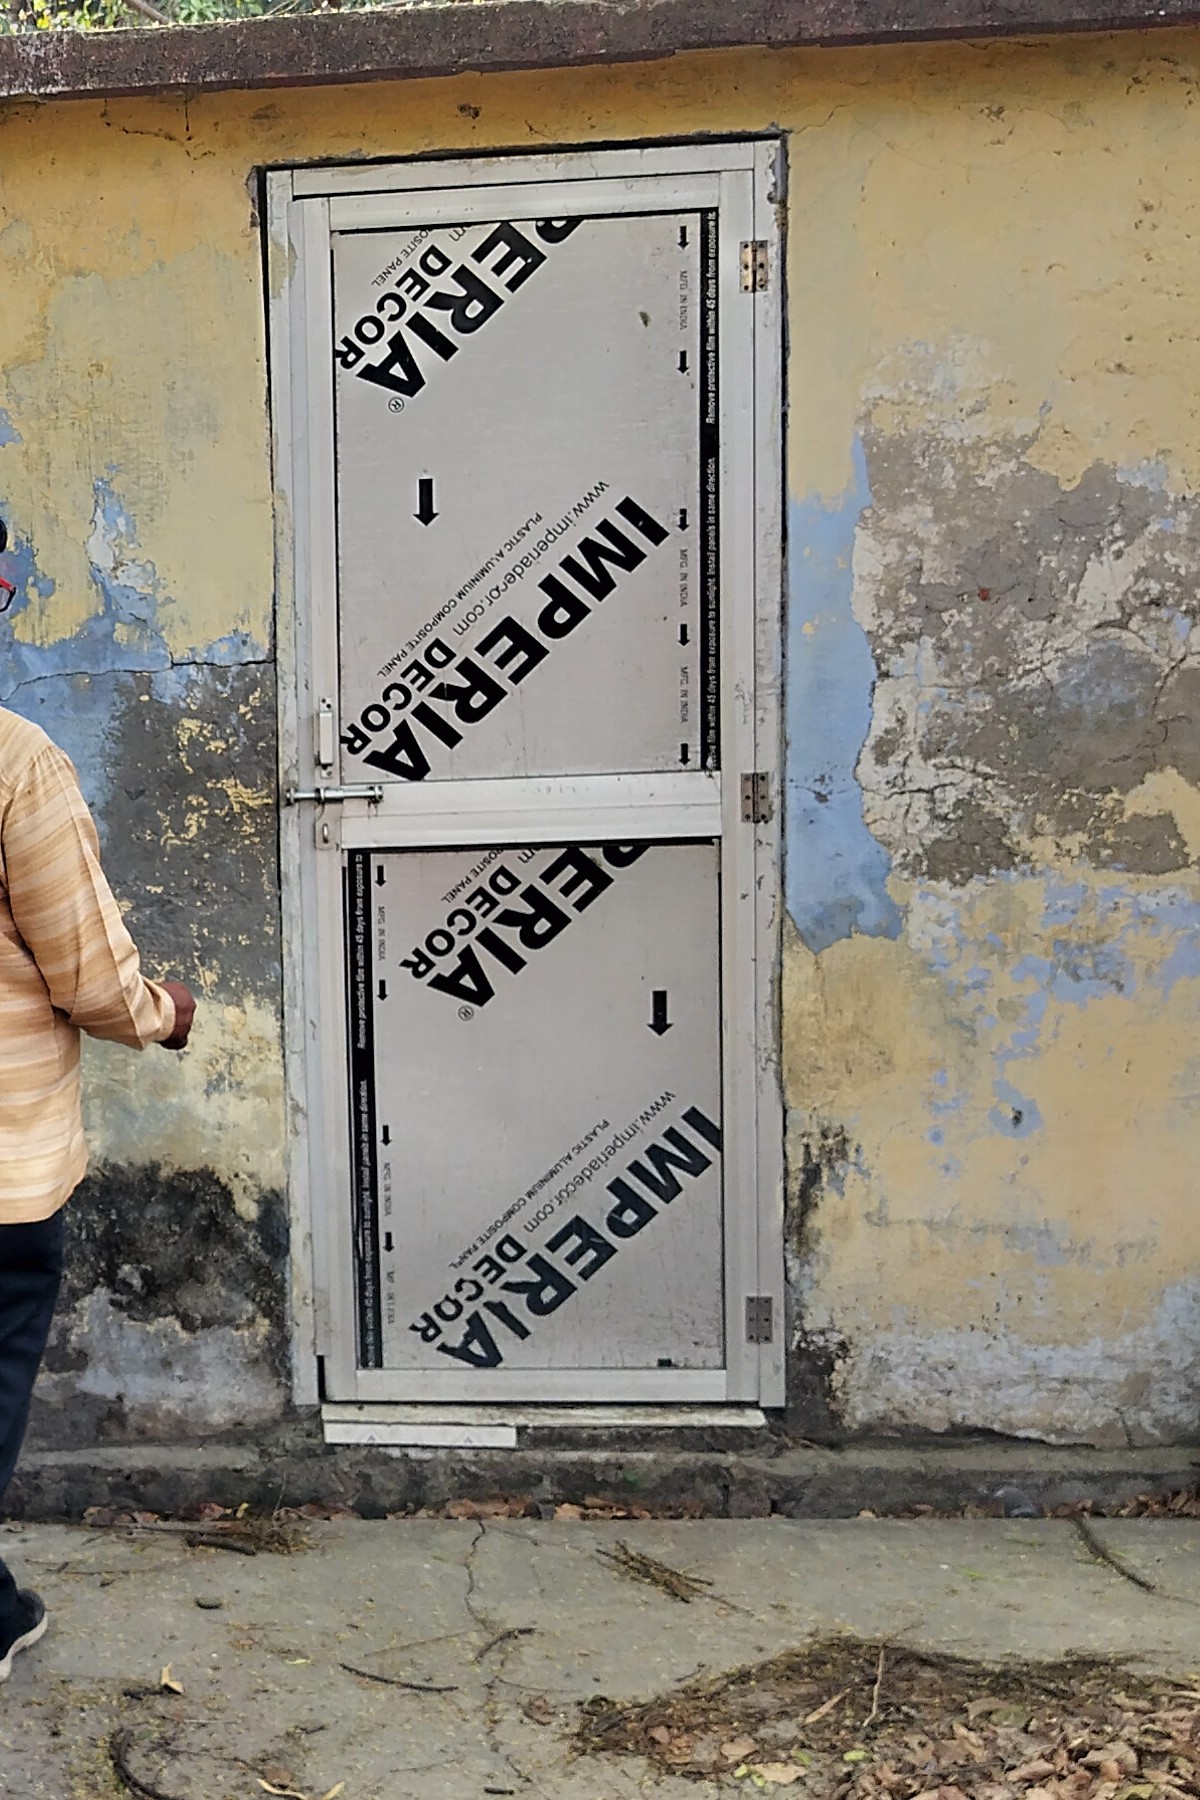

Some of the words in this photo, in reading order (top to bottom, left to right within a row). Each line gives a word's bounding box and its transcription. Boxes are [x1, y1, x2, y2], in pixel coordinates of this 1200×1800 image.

[400, 228, 432, 259] OSITE
[371, 257, 403, 287] PANEL
[335, 244, 453, 370] DECOR
[706, 311, 716, 334] within
[706, 352, 717, 391] protective
[706, 393, 716, 424] Remove
[506, 511, 543, 552] PLASTIC
[362, 496, 670, 782] IMPERIA
[407, 598, 458, 652] COMPOSITE
[377, 648, 408, 678] PANEL
[340, 637, 457, 756] DECOR
[441, 876, 473, 904] PANEL
[399, 864, 522, 979] DECOR
[571, 1119, 610, 1155] PLASTIC
[436, 1105, 723, 1368] IMPERIA
[409, 1233, 528, 1344] DECOR
